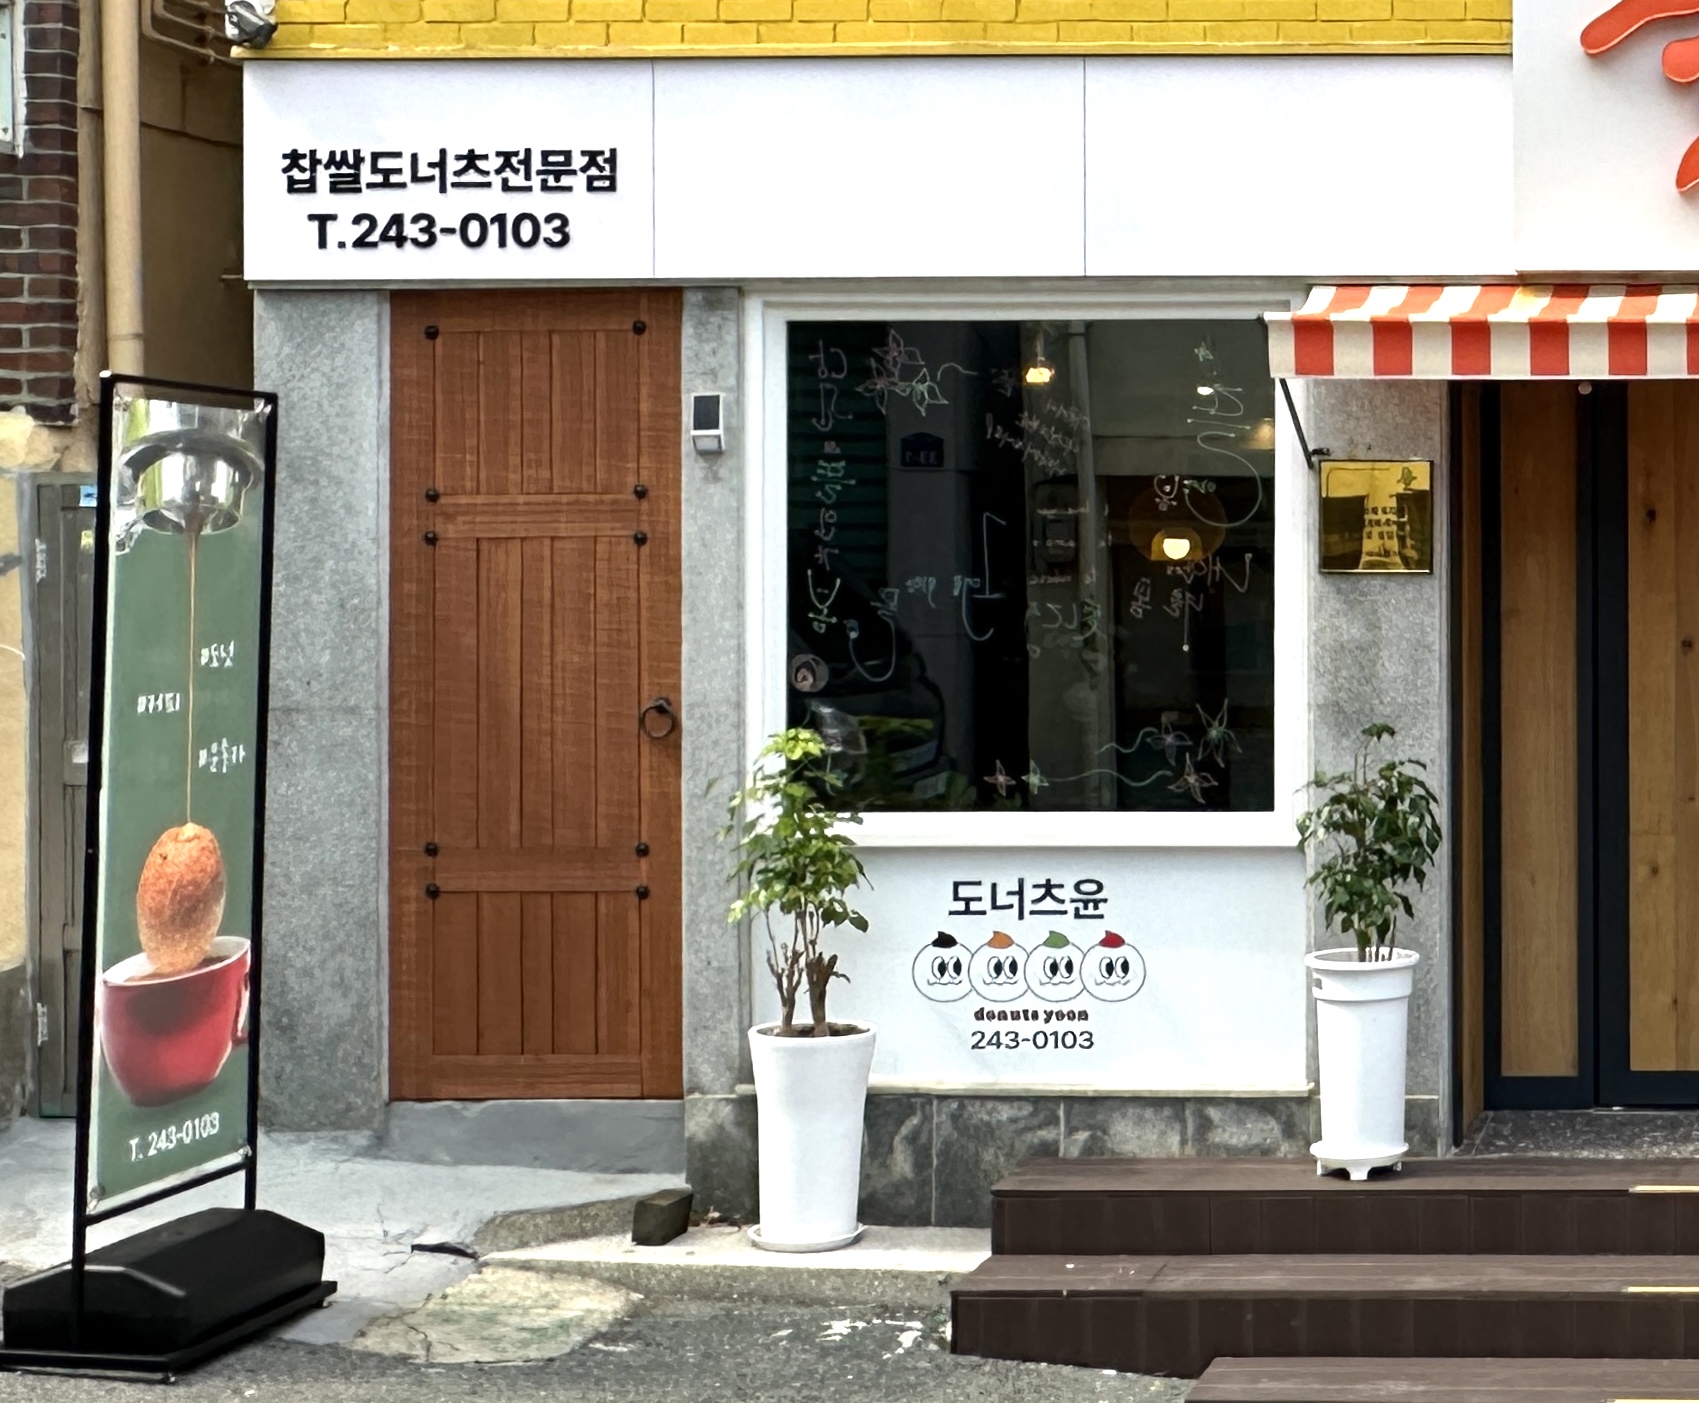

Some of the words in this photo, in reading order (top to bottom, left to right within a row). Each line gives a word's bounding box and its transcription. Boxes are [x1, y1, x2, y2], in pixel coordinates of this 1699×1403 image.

[281, 147, 618, 194] 찹쌀도너츠전문점
[307, 212, 571, 250] T.243-0103
[948, 877, 1109, 921] 도너츠윤
[970, 1030, 1095, 1050] 243-0103
[147, 1111, 221, 1158] 243-0103
